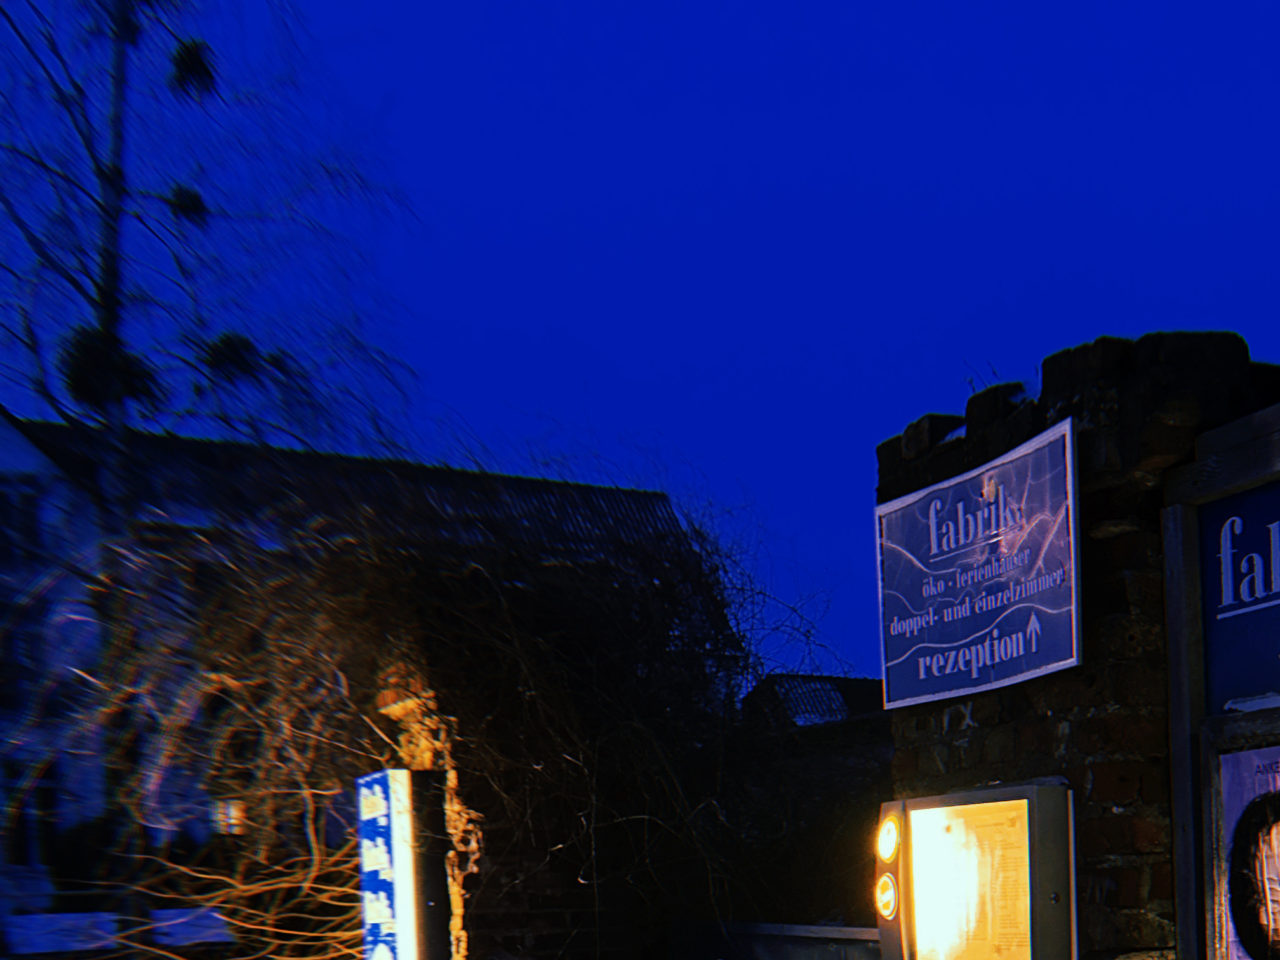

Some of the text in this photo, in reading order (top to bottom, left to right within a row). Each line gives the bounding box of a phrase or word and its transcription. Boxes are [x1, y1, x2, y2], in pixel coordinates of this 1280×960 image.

[922, 576, 945, 598] öko
[890, 610, 938, 638] doppel-
[943, 596, 970, 622] und
[918, 628, 1025, 680] rezeption
